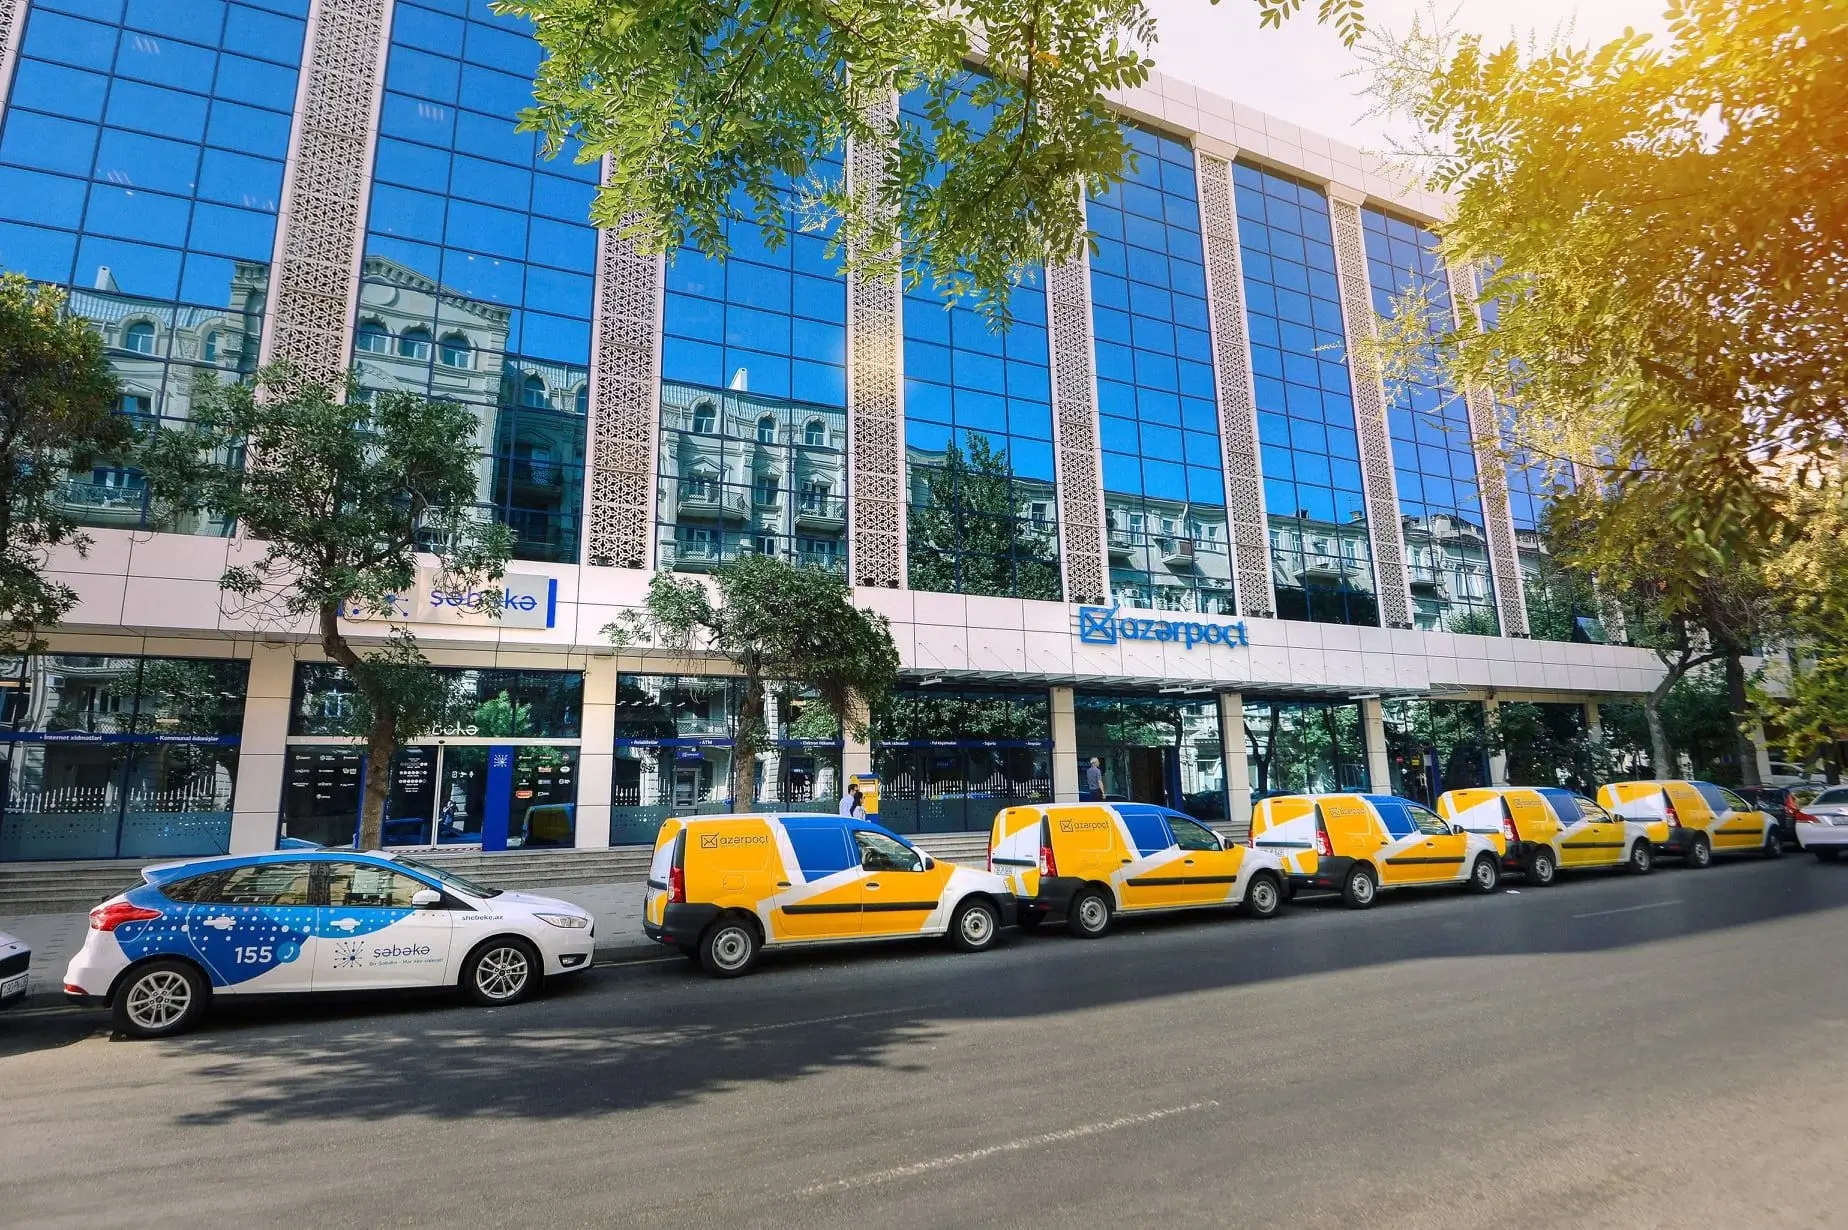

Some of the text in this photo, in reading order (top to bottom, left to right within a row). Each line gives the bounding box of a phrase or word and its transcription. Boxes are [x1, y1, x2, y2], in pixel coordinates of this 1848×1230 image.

[430, 582, 538, 611] şəbkə
[1119, 616, 1249, 650] azərpoçt
[719, 834, 769, 846] azərpoçt
[234, 946, 273, 964] 155
[373, 943, 431, 958] şəbəkə
